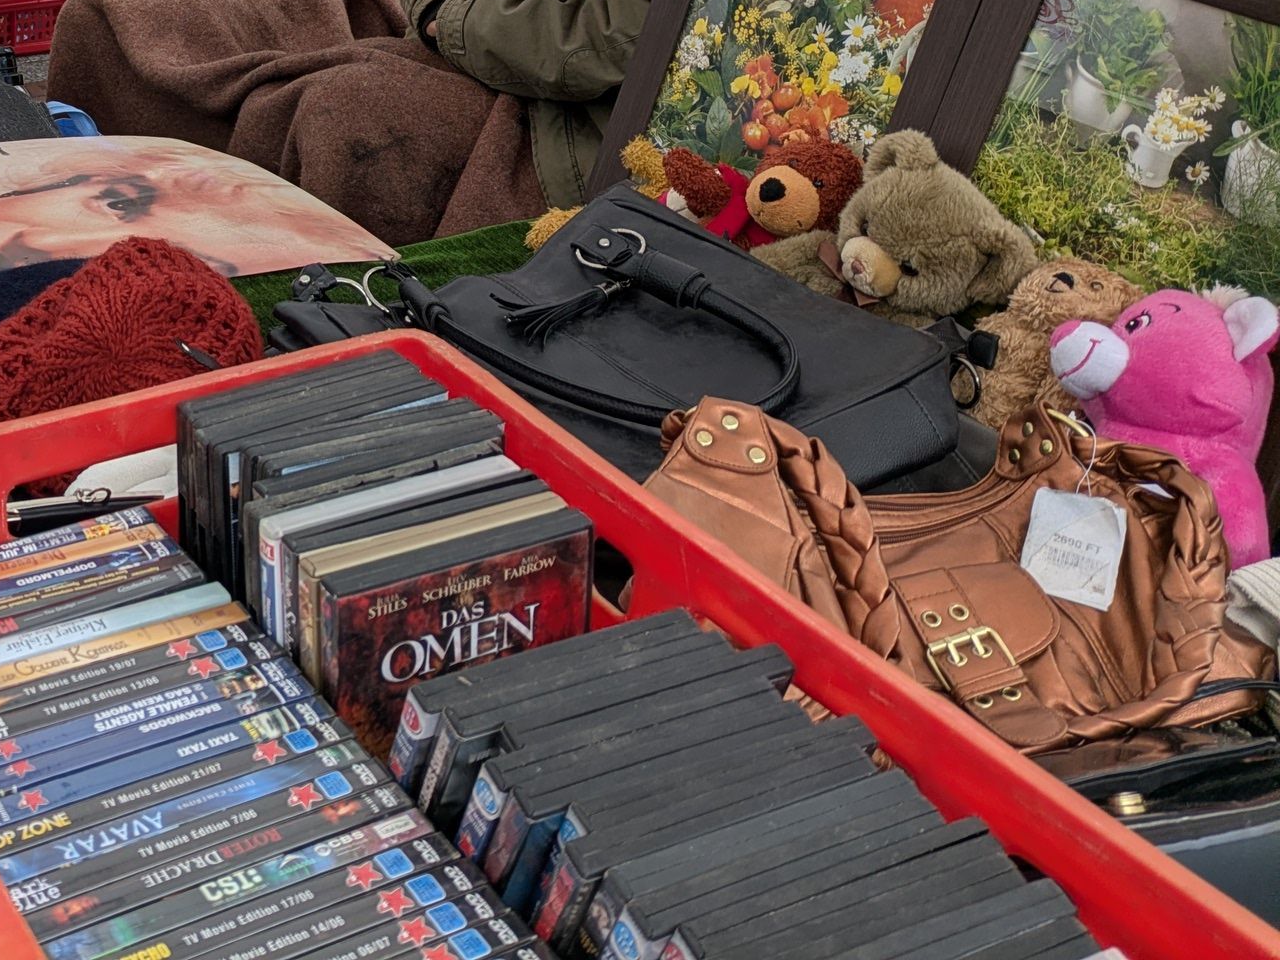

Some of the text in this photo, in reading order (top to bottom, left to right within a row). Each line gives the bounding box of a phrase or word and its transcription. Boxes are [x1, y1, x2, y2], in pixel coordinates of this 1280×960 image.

[15, 555, 96, 591] DOPPELMORD
[503, 556, 557, 582] FARROW
[422, 574, 492, 604] SCHREIBER
[368, 598, 408, 621] STILES
[441, 600, 486, 630] DAS
[3, 629, 54, 656] Eisbär
[53, 614, 107, 644] Kleiner
[380, 602, 540, 684] OMEN
[23, 686, 39, 696] TV
[40, 676, 69, 691] Movie
[71, 666, 106, 685] Edition
[167, 685, 192, 701] SAG
[44, 705, 60, 716] TV
[62, 695, 89, 712] Movie
[92, 685, 128, 704] Edition
[93, 703, 131, 723] WORT
[131, 692, 168, 711] KEIN
[147, 692, 199, 718] FEMALE
[93, 707, 149, 734] AGENTS
[137, 700, 223, 736] BACKWOODS
[176, 729, 239, 759] TAXI TAXI
[102, 799, 117, 809] TV
[119, 787, 149, 805] Movie
[152, 774, 189, 795] Edition
[17, 810, 71, 841] ZONE
[52, 809, 166, 862] AVATAR
[138, 848, 153, 859] TV
[157, 835, 189, 853] Movie
[192, 822, 230, 842] Edition
[137, 847, 225, 890] DRACHE
[200, 830, 365, 904] CSI: CBS
[182, 890, 315, 946] TV Movie Edition 17/06
[267, 931, 310, 954] Edition
